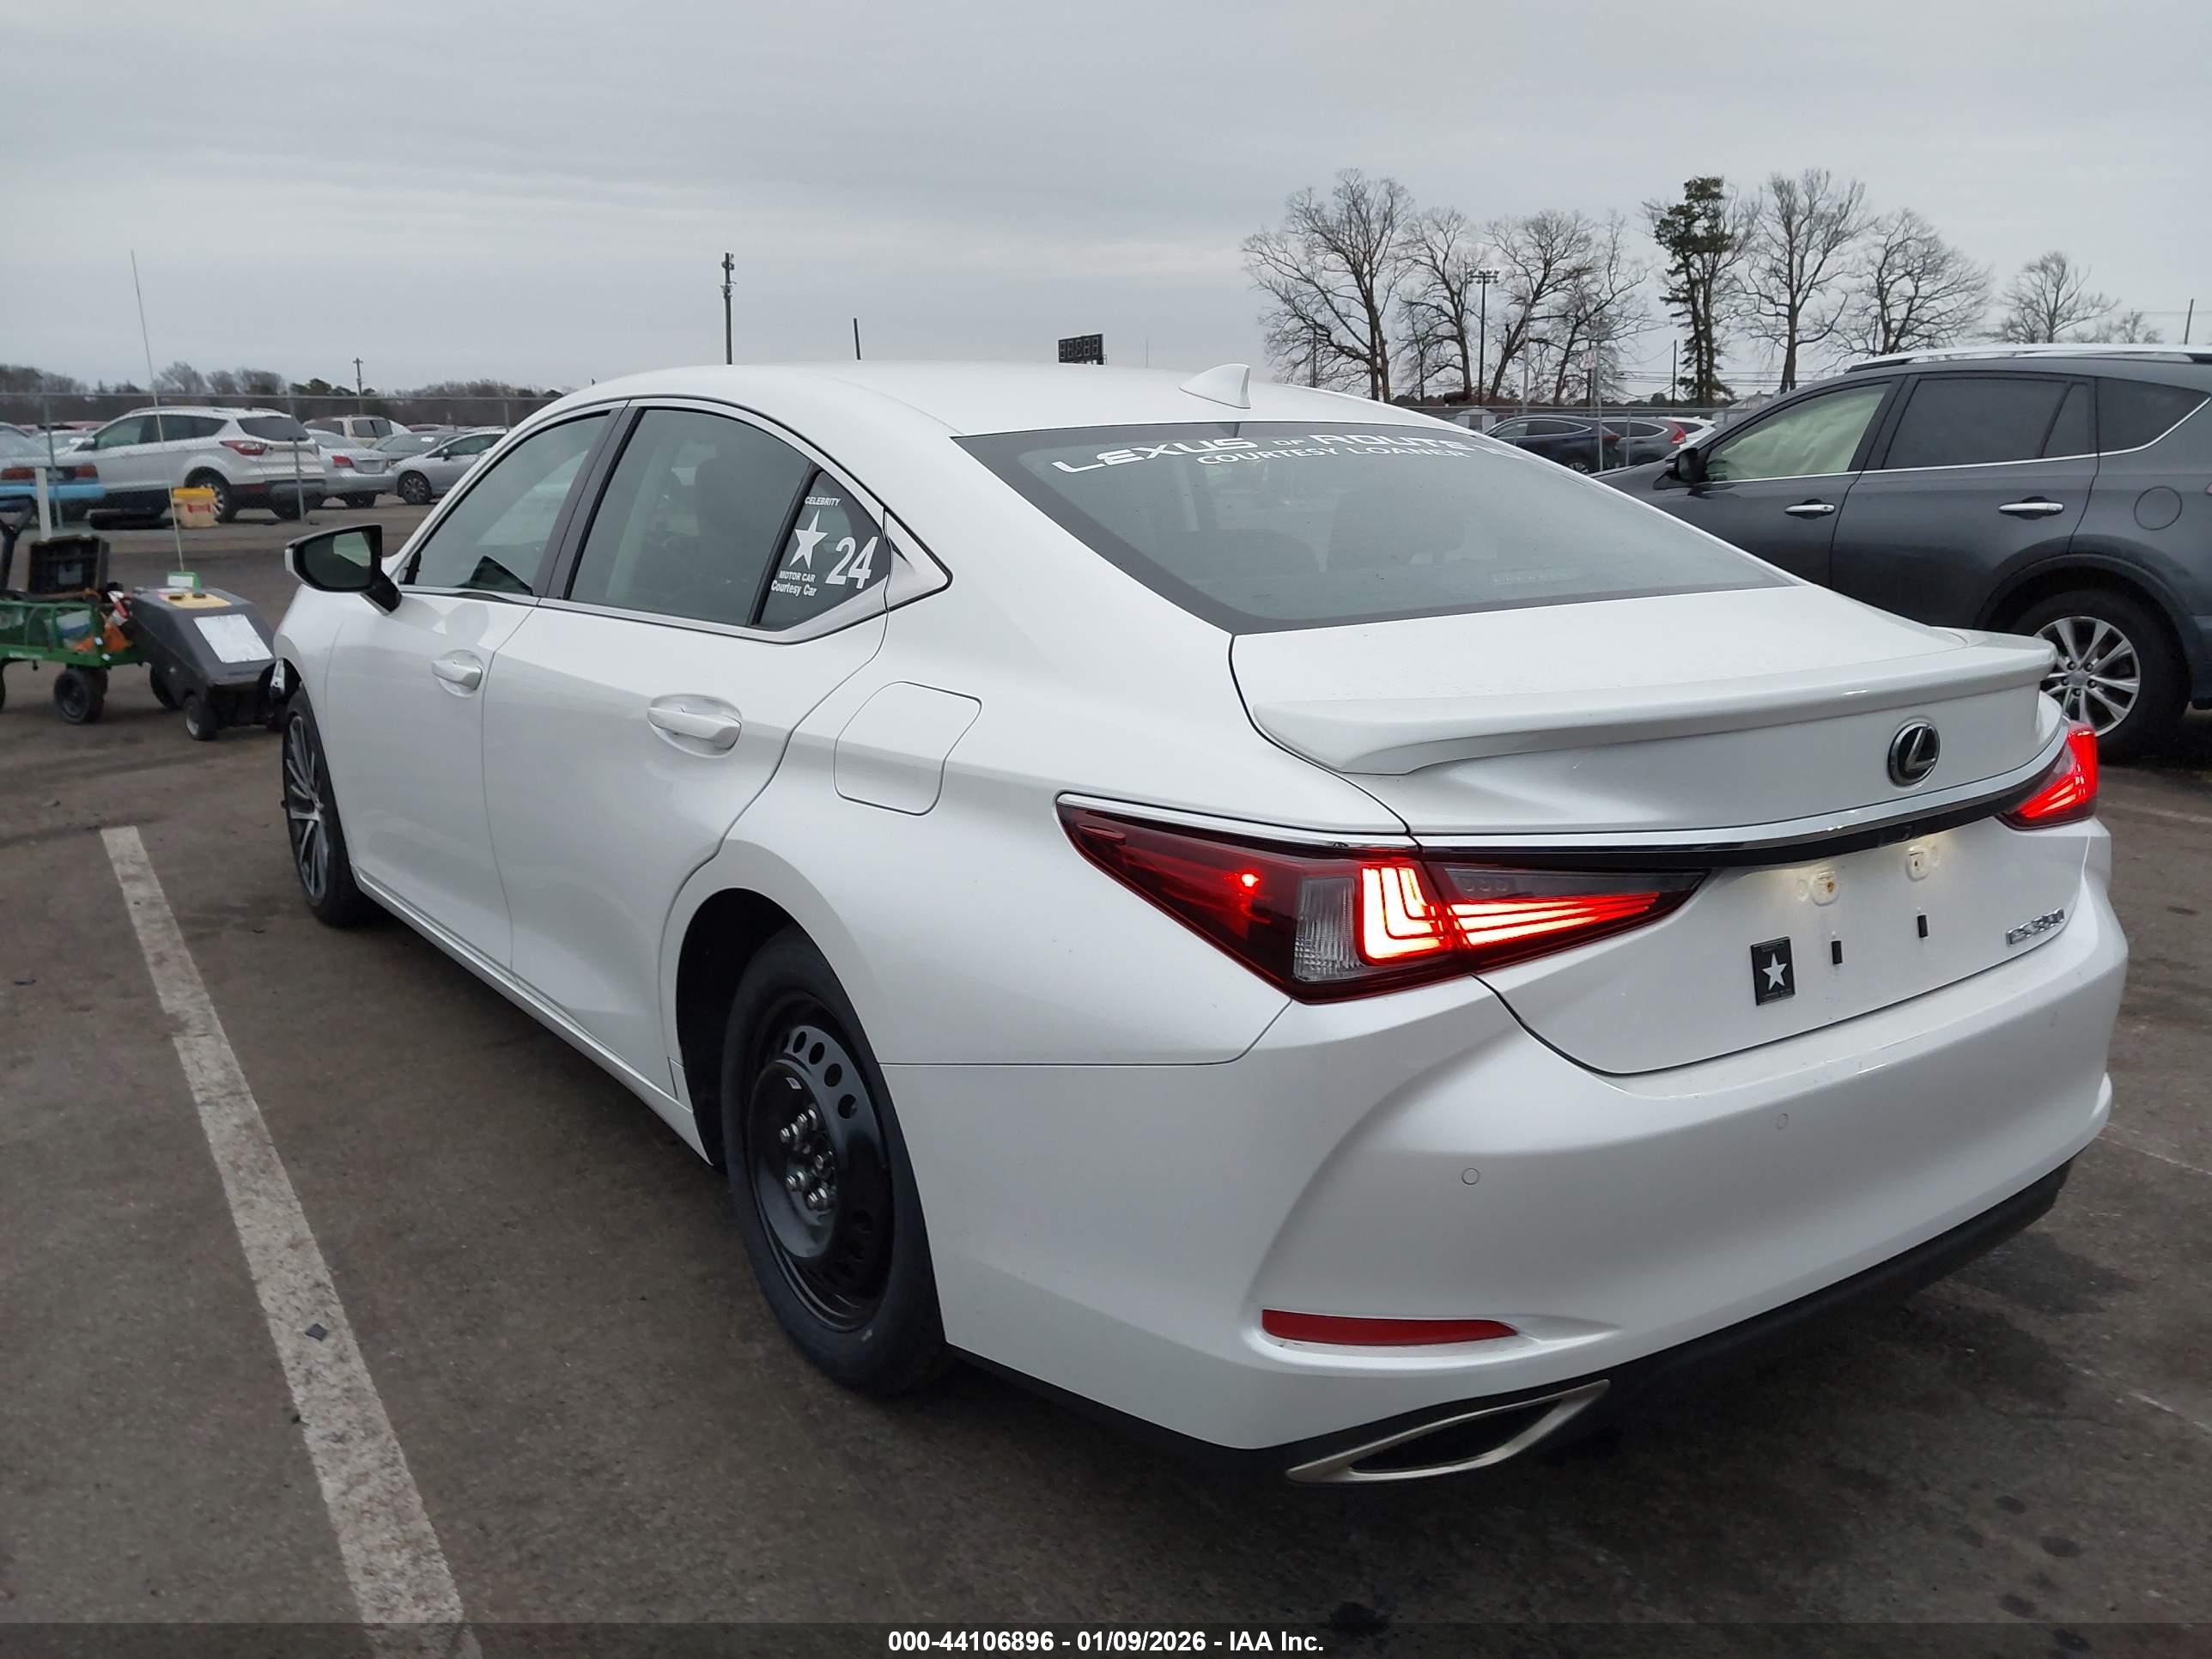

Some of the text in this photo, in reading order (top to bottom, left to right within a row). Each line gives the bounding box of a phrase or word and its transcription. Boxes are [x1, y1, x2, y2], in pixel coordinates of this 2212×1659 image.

[1052, 437, 1258, 473] LEXUS
[1308, 434, 1475, 452] ROUTE
[1196, 447, 1340, 465] COURTESY
[1346, 446, 1471, 459] LOANER
[805, 495, 842, 507] CELEBRITY
[825, 536, 878, 589] 24
[779, 569, 817, 584] MOTOR CAR
[771, 579, 818, 597] Courtesy Car
